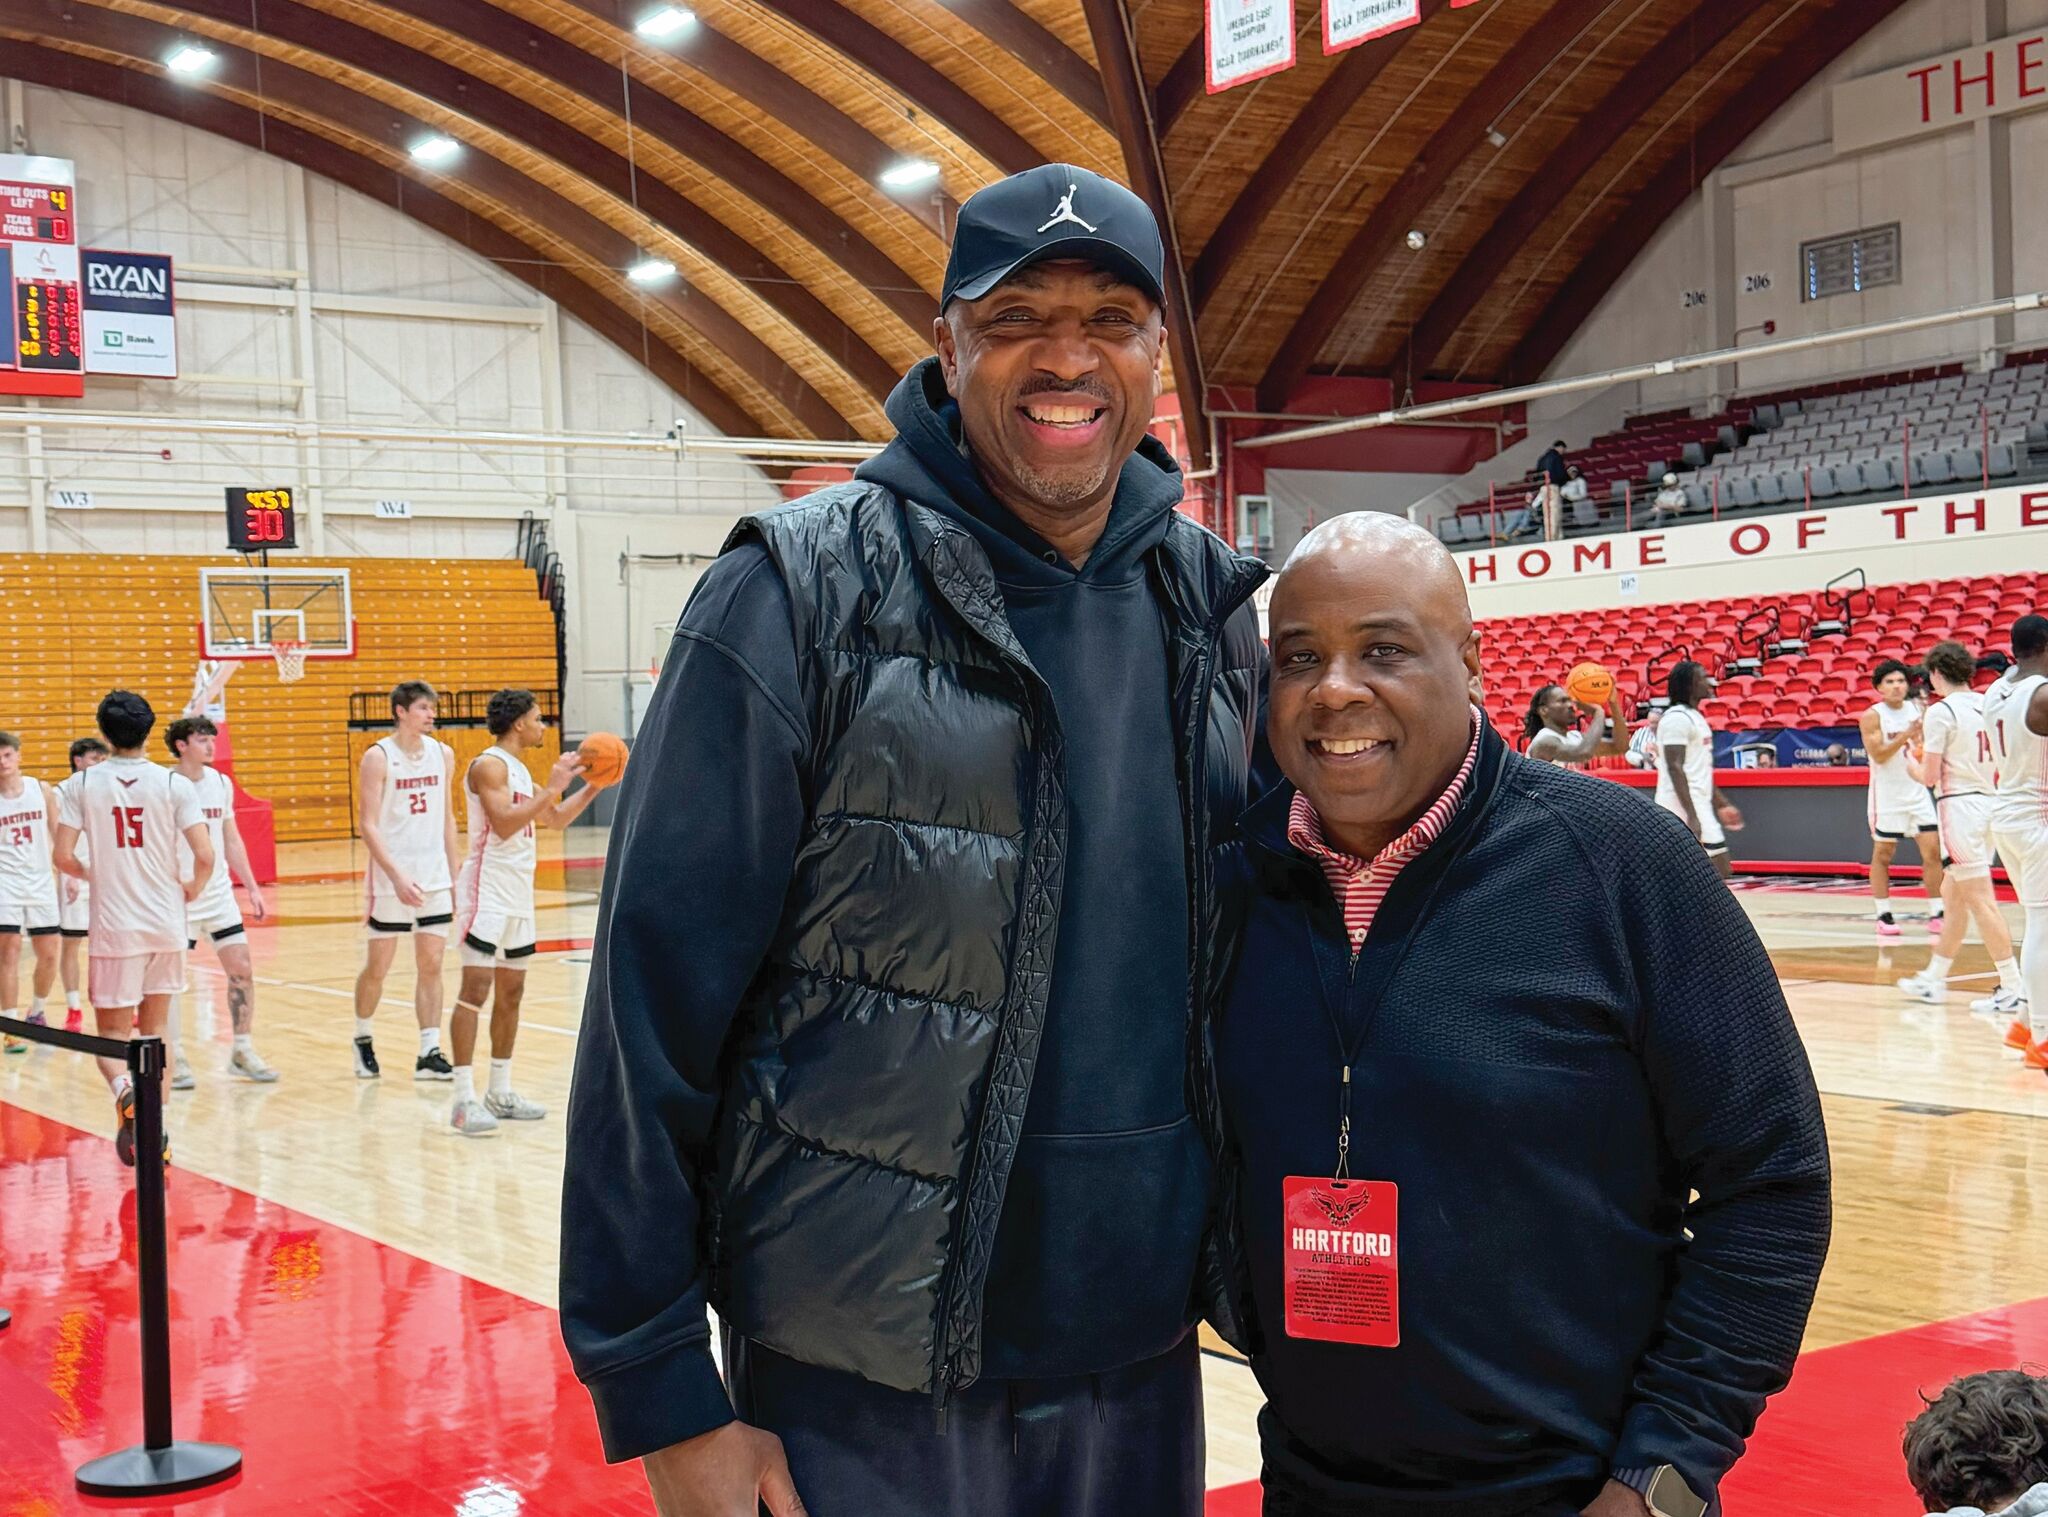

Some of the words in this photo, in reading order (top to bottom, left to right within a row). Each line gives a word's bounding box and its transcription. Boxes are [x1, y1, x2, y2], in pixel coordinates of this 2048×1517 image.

[1907, 36, 2046, 123] THE
[50, 191, 67, 210] 4
[52, 218, 68, 239] 0
[88, 262, 166, 293] RYAN
[103, 330, 123, 348] TD
[126, 335, 154, 345] Bank
[58, 490, 88, 506] W3
[381, 501, 406, 514] W4
[246, 509, 284, 541] 30
[1468, 534, 1667, 584] HOME
[1729, 515, 1827, 556] OF
[1880, 491, 2048, 540] THE
[409, 791, 427, 815] 25
[0, 809, 42, 827] ARTFORD
[111, 806, 145, 848] 15
[1292, 1228, 1391, 1257] HARTFORD
[1311, 1252, 1371, 1267] ATHLETICS
